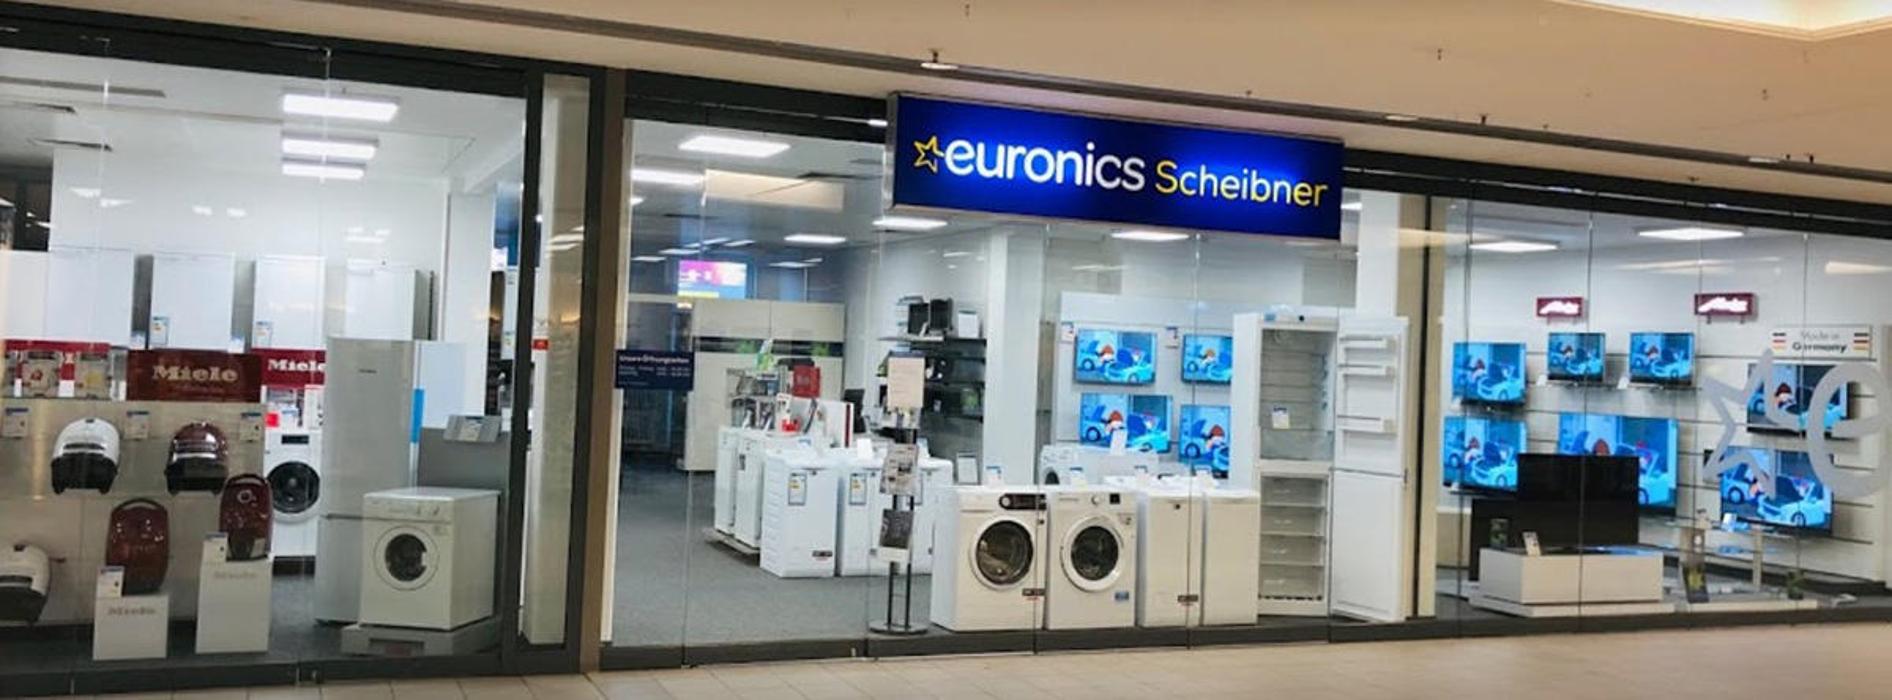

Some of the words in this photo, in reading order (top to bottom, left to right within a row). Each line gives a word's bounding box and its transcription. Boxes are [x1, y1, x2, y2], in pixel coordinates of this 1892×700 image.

[944, 139, 1145, 192] euronics
[1155, 159, 1328, 206] Scheibner
[1792, 341, 1847, 353] Germany
[152, 364, 238, 382] Miele
